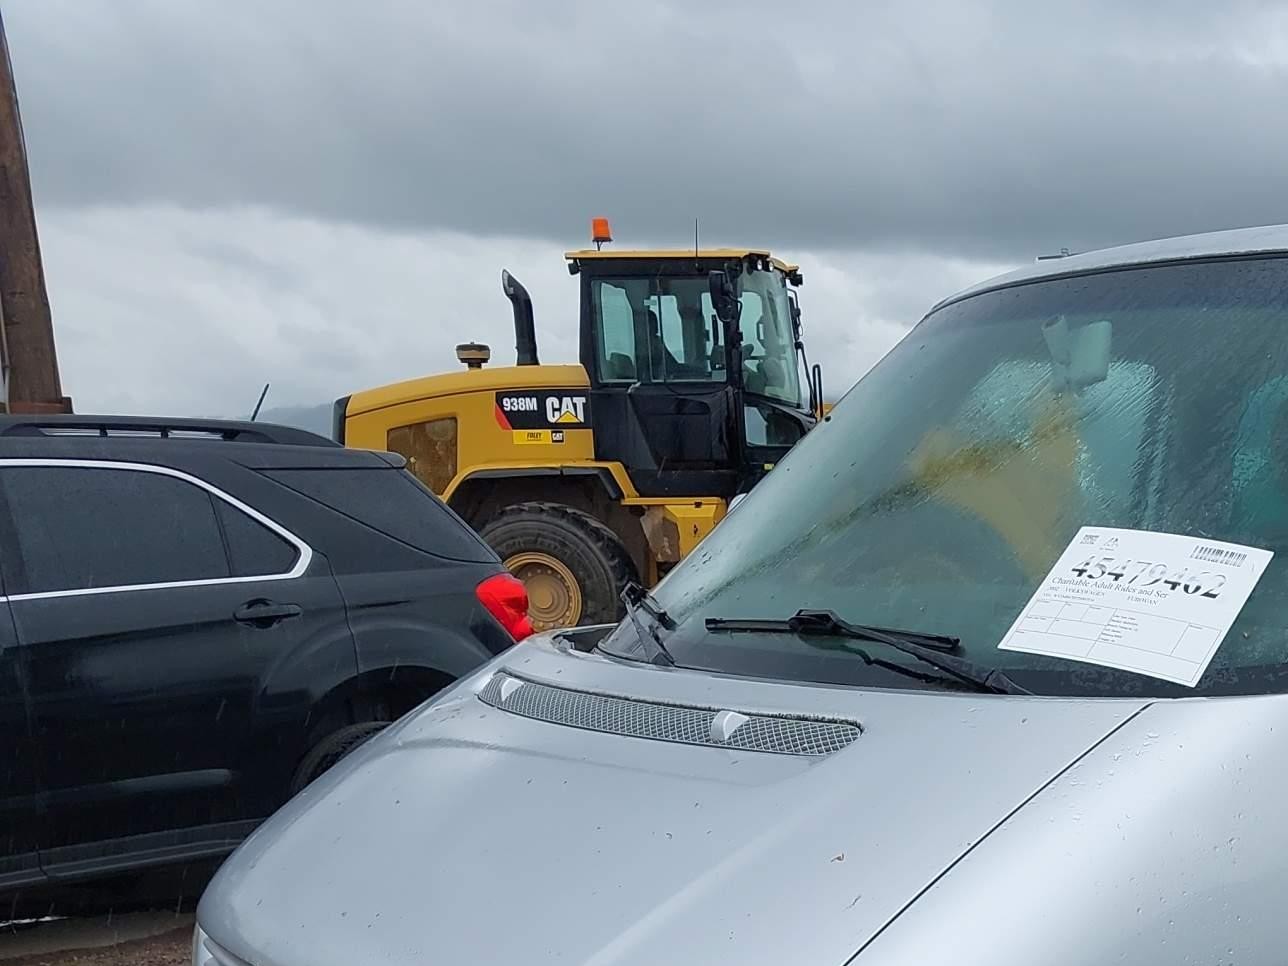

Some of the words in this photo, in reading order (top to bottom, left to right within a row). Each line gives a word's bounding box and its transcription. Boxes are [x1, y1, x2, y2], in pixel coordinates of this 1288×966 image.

[503, 397, 537, 411] 938M
[545, 396, 586, 423] CAT
[1051, 576, 1091, 588] Charitable
[1092, 580, 1114, 590] Adult
[1113, 583, 1138, 594] Rides
[1137, 587, 1154, 596] and
[1071, 555, 1227, 599] 45479462
